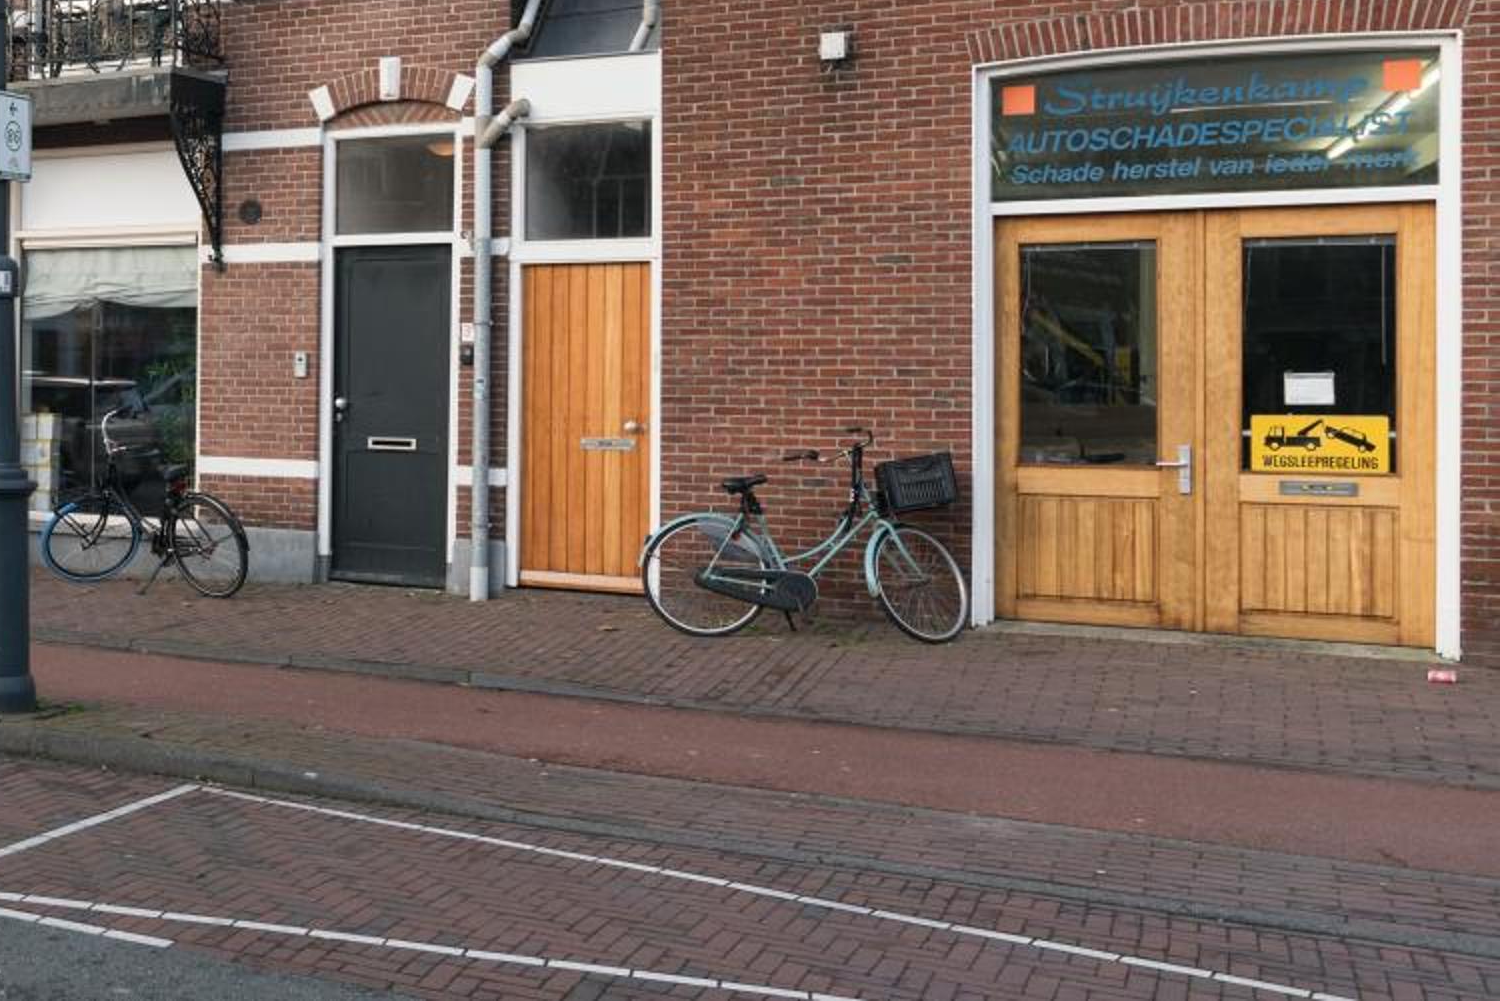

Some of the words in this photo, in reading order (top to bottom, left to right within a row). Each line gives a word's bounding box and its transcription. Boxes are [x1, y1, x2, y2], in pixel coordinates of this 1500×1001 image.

[1009, 111, 1413, 153] AUTOSCHADESPECIALIST
[1011, 160, 1104, 185] Schade
[1112, 156, 1201, 181] herstel
[1208, 158, 1253, 175] van
[1265, 152, 1331, 174] ieder
[1262, 454, 1379, 470] WEGSLEEPREGELING
